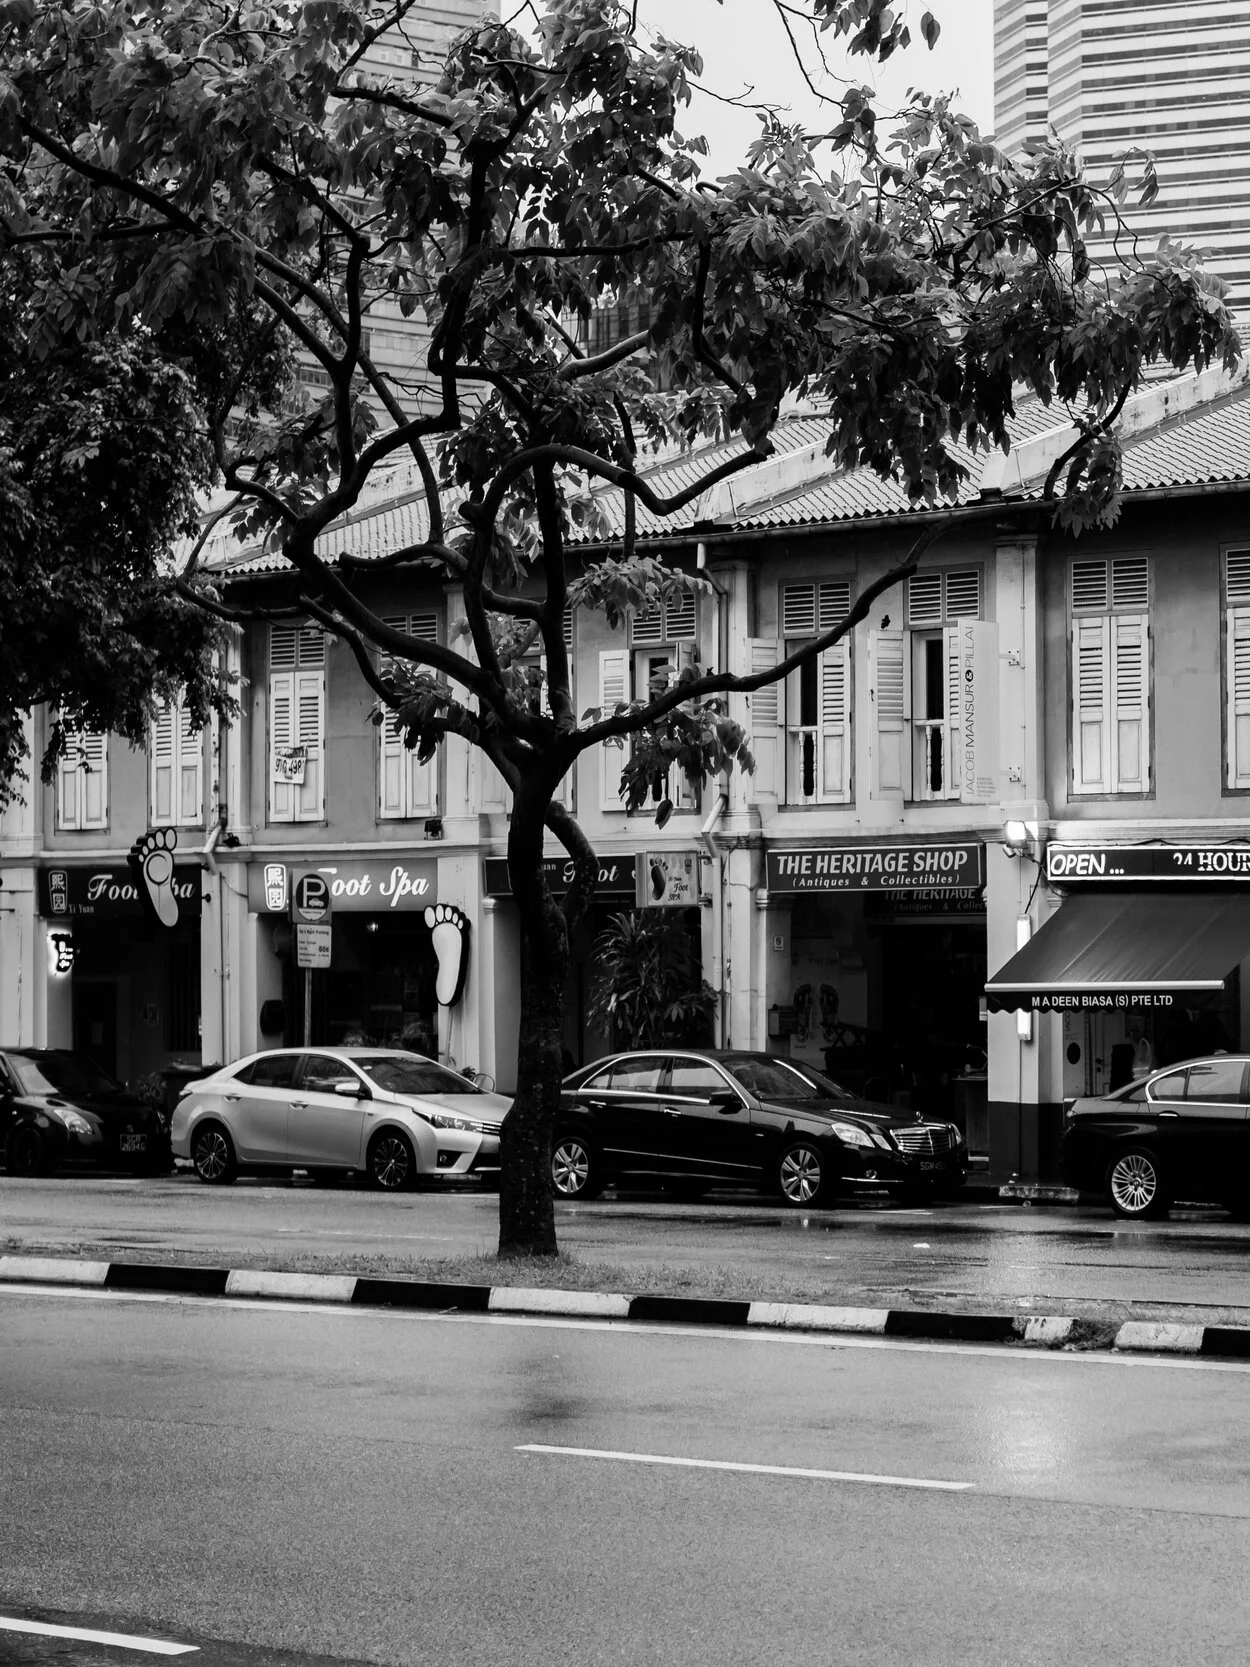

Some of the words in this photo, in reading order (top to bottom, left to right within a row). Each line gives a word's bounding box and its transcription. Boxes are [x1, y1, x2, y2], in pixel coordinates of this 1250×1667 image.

[965, 626, 974, 668] PILLAI
[965, 684, 975, 748] MANSUR
[966, 750, 975, 795] JACOB
[777, 855, 812, 875] THE
[815, 853, 909, 875] HERITAGE
[913, 850, 968, 872] SHOP
[1050, 854, 1106, 876] OPEN
[379, 866, 429, 907] Spa
[792, 877, 850, 888] (Antiques
[861, 876, 869, 886] &
[880, 874, 960, 885] Collectibles)
[1032, 997, 1041, 1006] M
[1042, 997, 1050, 1006] A
[1052, 996, 1078, 1006] DEEN
[1082, 996, 1113, 1006] BIASA
[1115, 994, 1129, 1007] (S)
[1131, 996, 1151, 1006] PTE
[1154, 995, 1173, 1005] LTD
